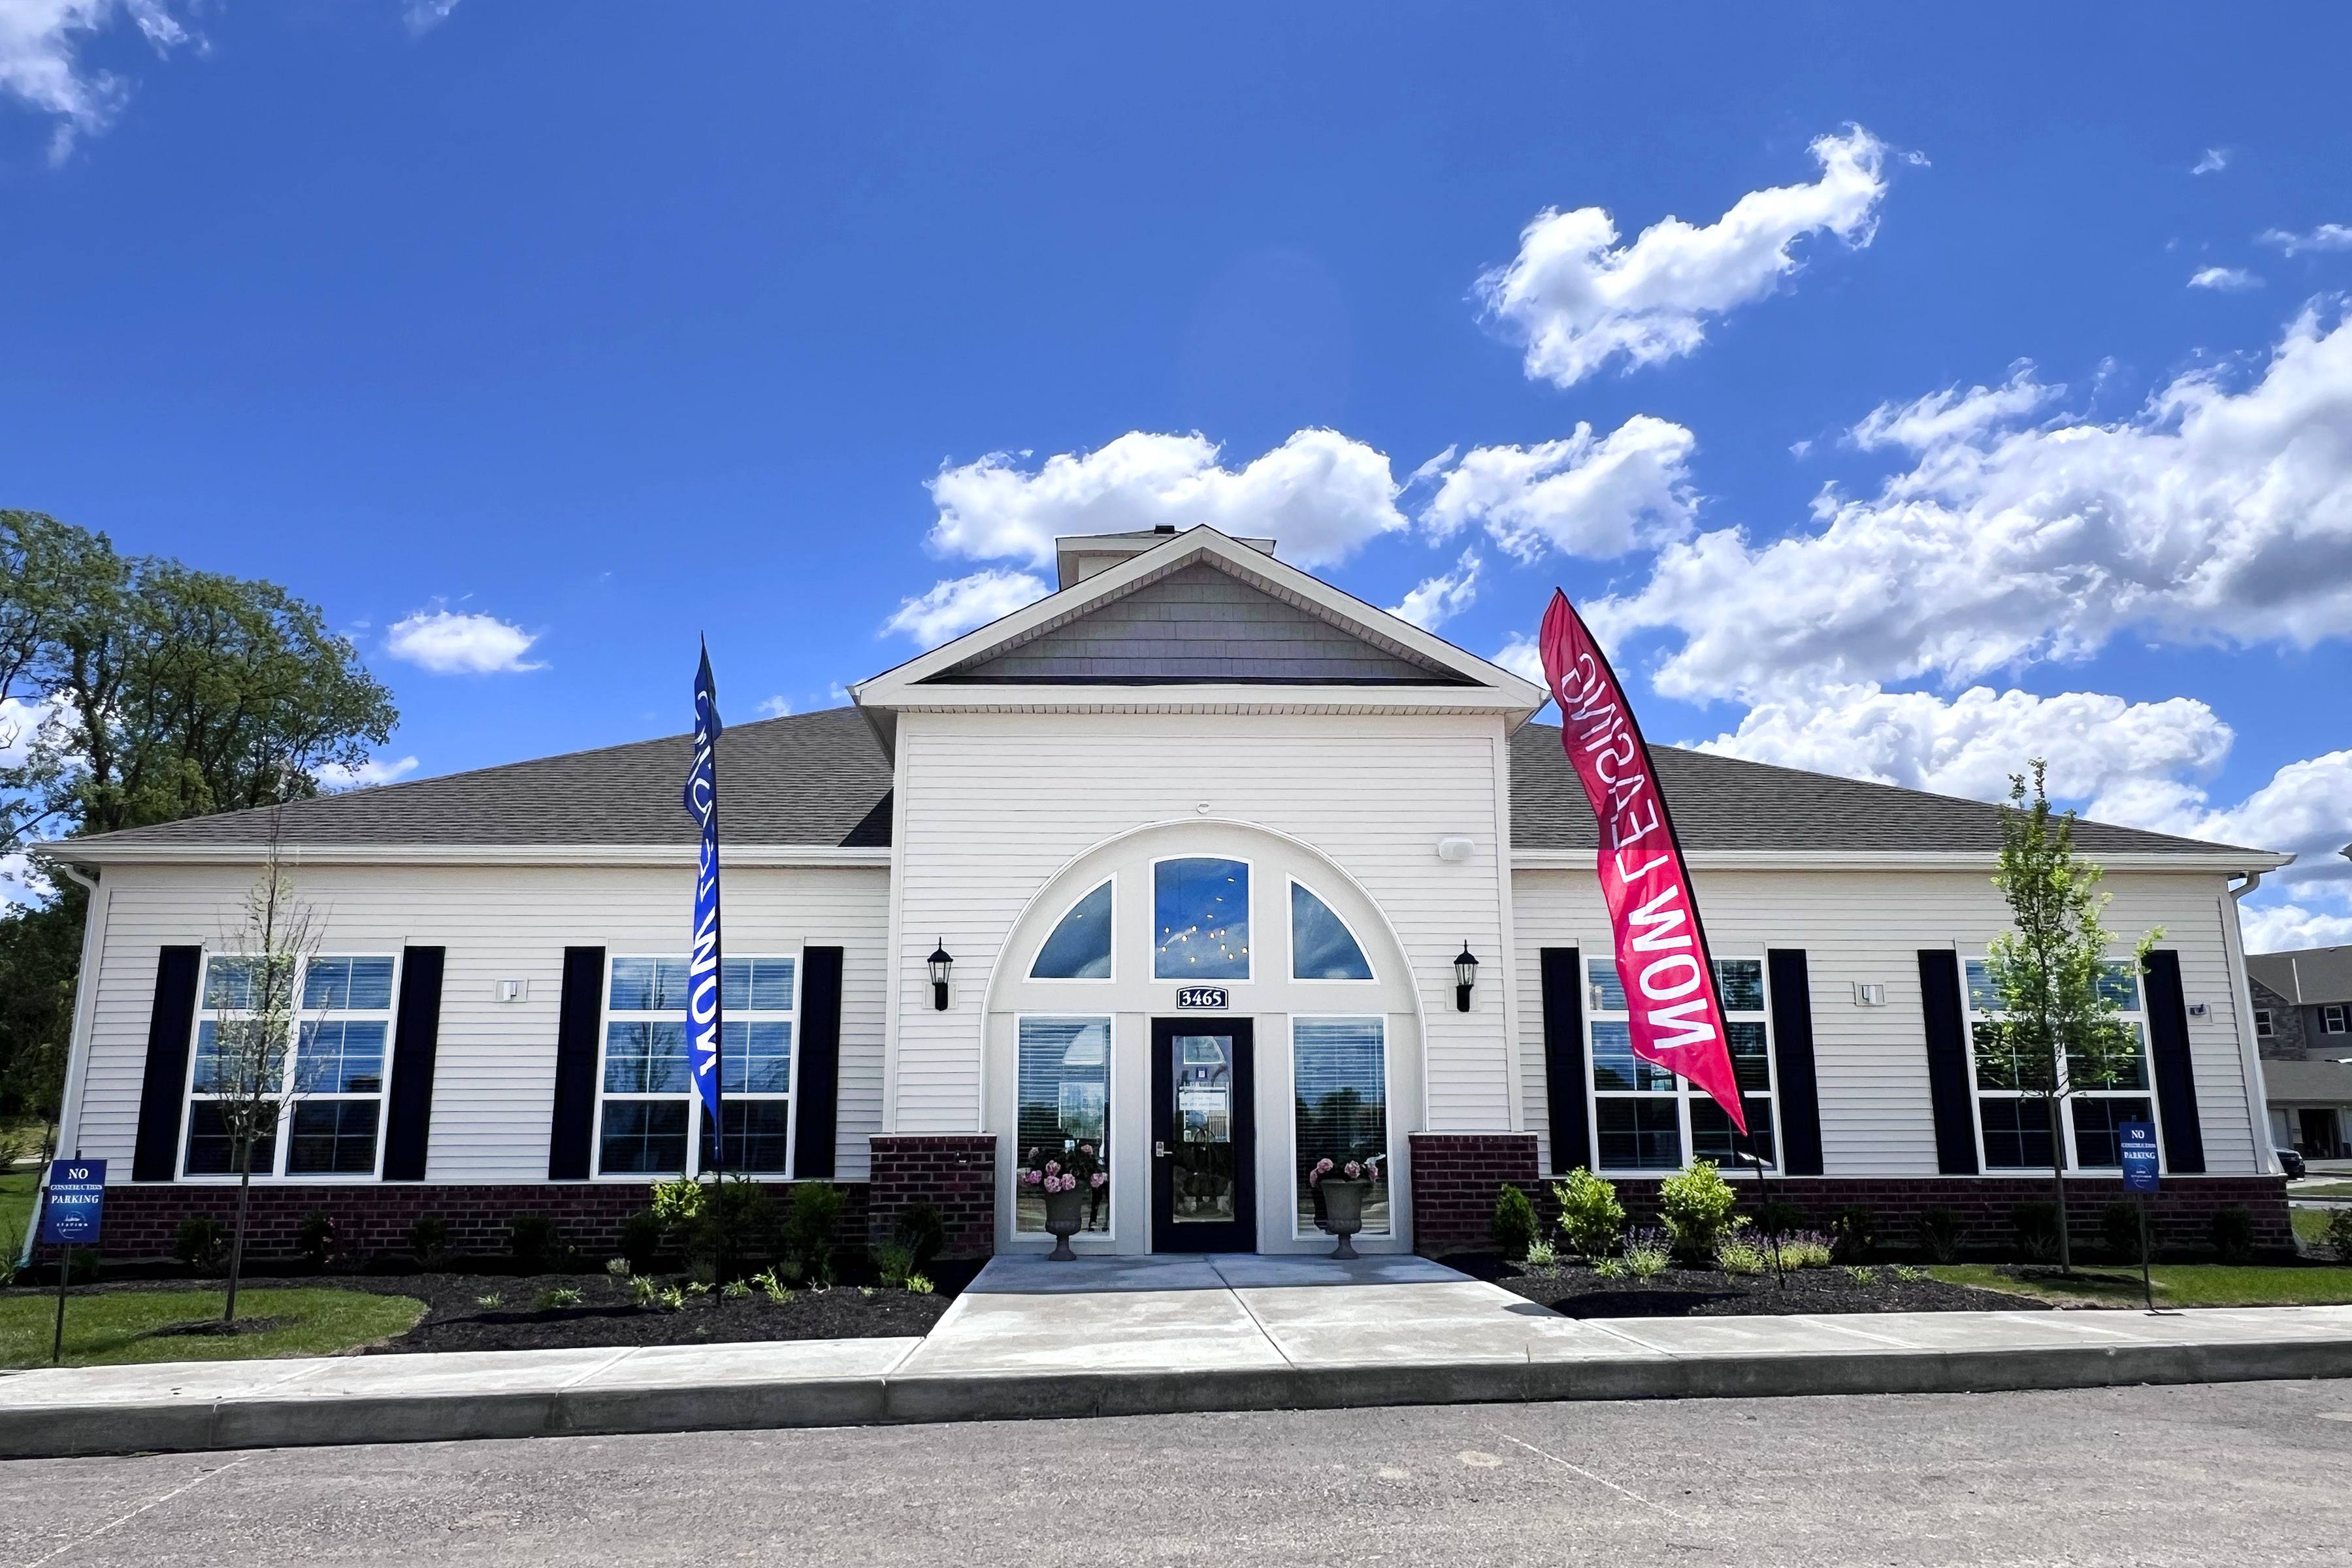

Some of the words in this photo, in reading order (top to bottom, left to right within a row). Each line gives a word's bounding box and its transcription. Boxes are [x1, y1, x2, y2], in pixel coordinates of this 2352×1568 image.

[1182, 990, 1222, 1006] 3465
[2131, 1130, 2145, 1139] NO
[68, 1168, 89, 1179] NO
[52, 1195, 99, 1204] PARKING
